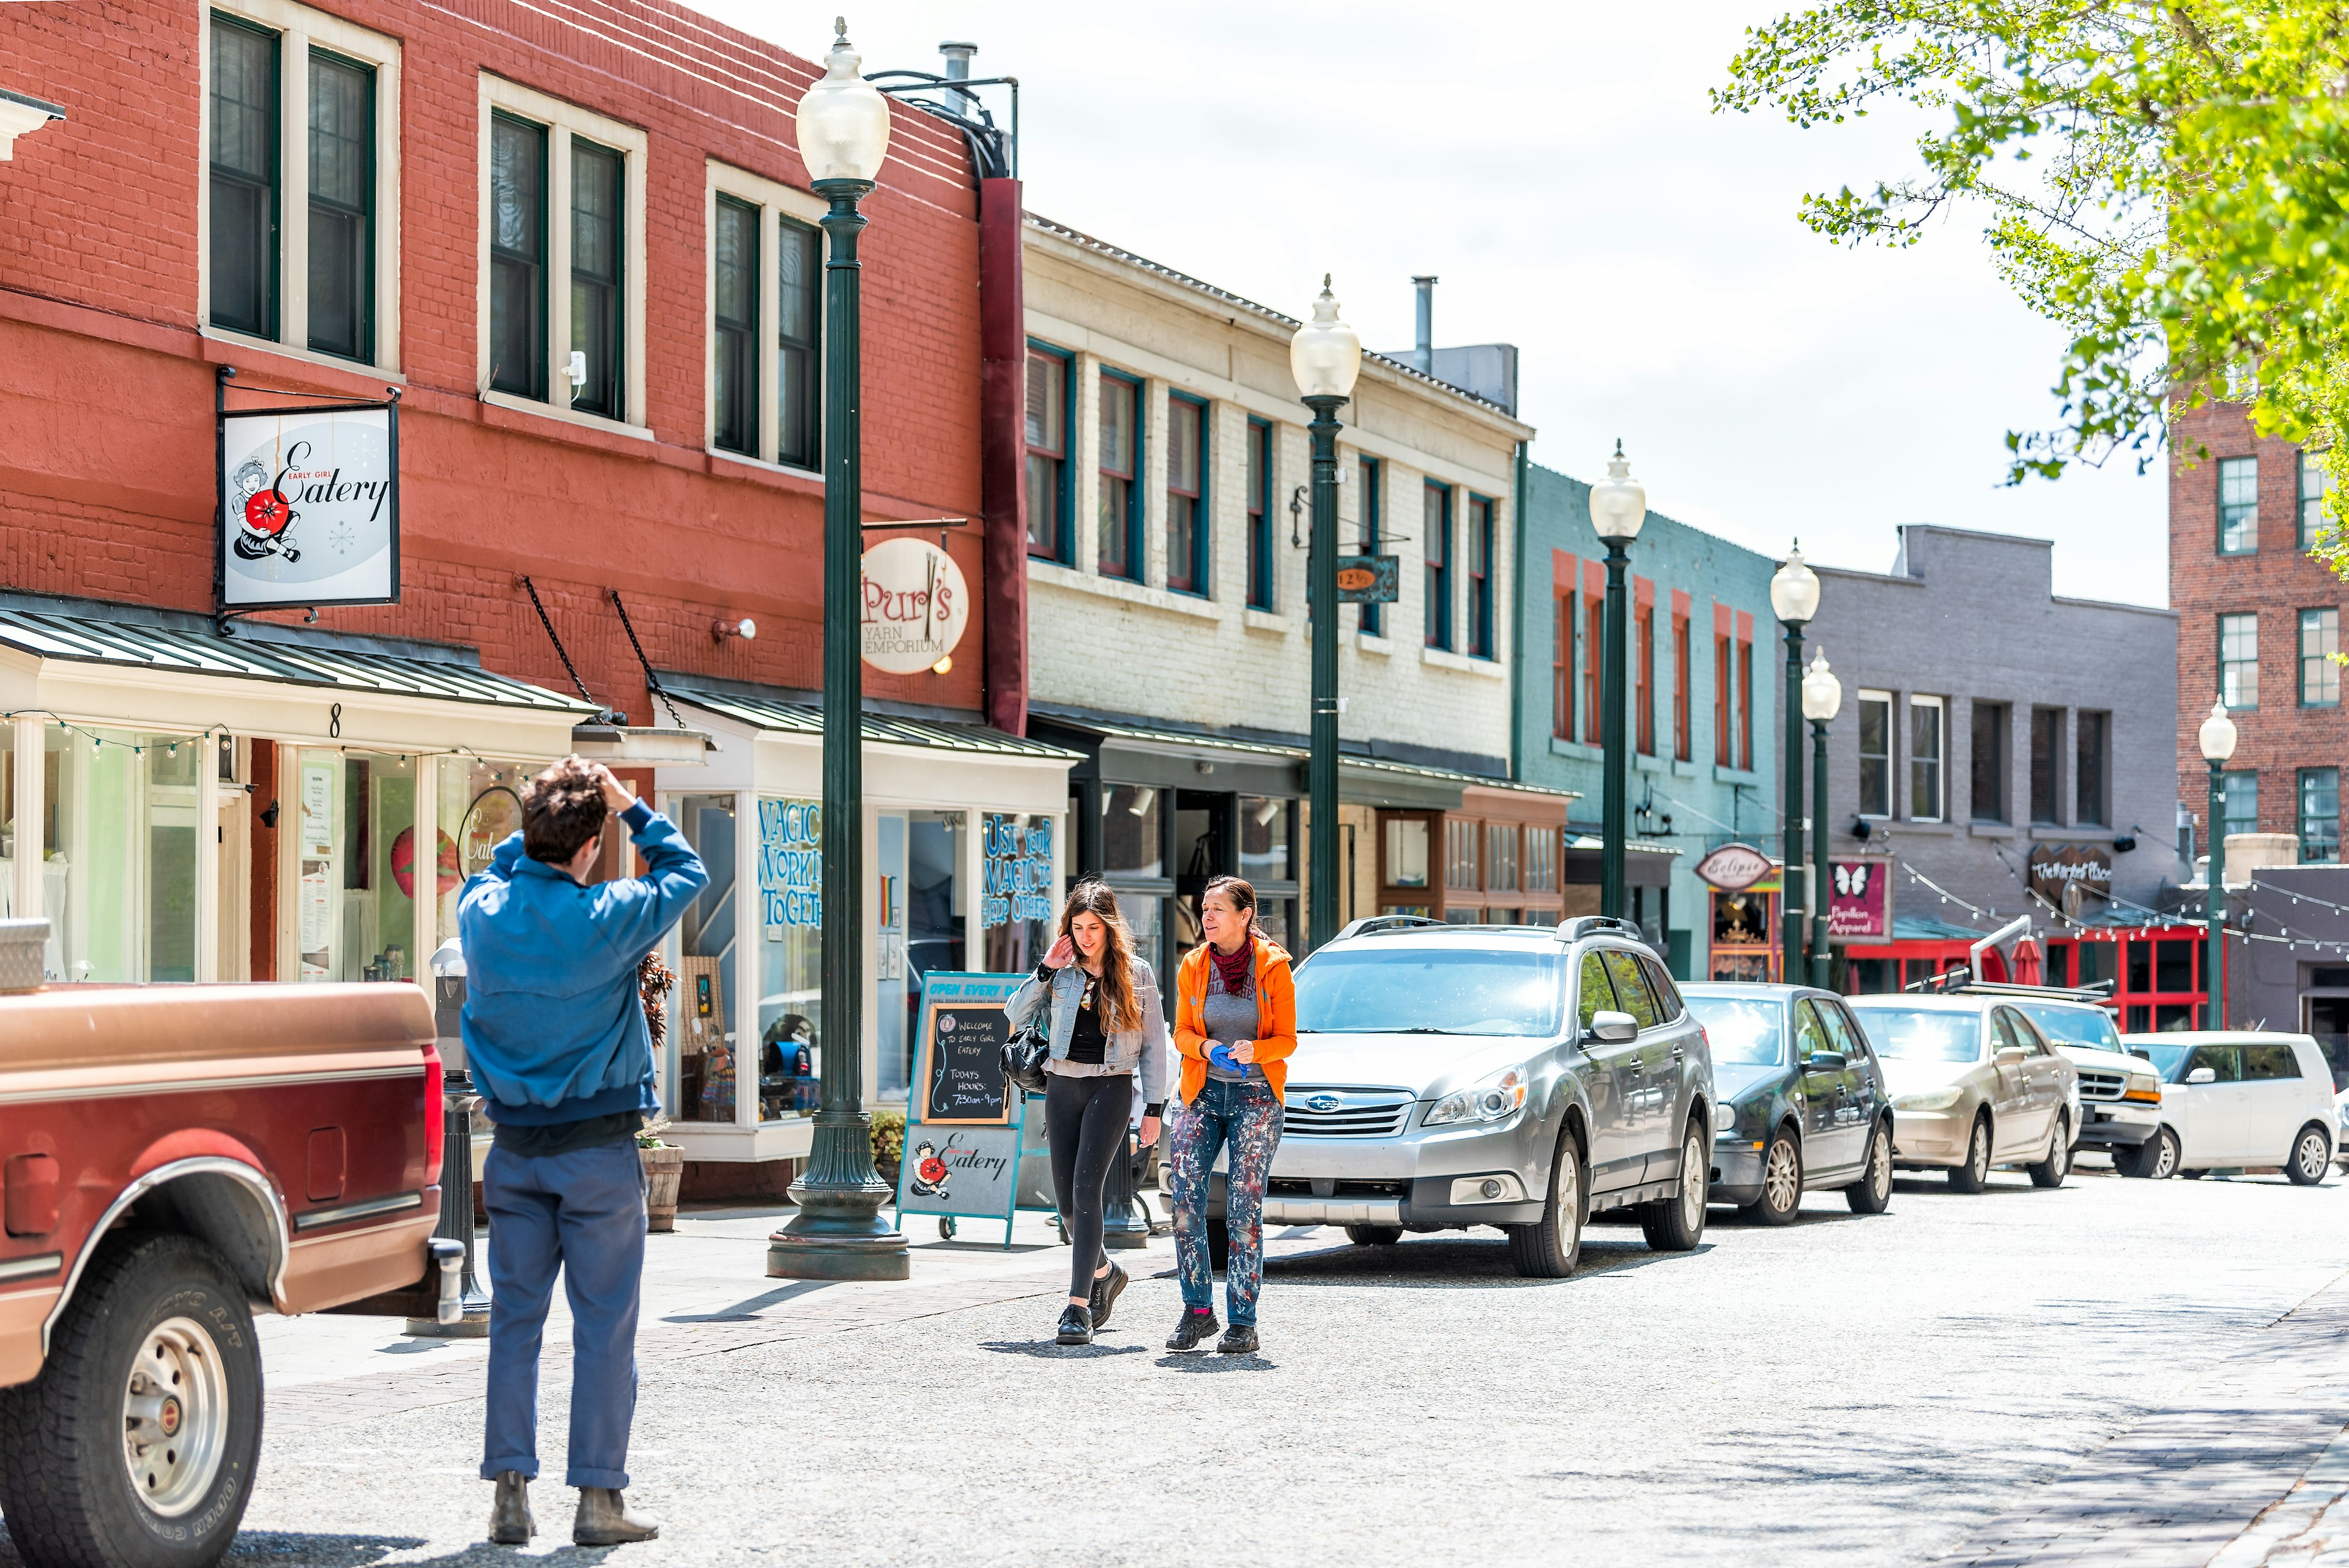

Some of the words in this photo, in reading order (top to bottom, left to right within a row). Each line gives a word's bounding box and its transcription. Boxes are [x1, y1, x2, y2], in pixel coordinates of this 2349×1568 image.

[272, 441, 390, 522] Eatery
[864, 626, 902, 640] YARN
[864, 639, 944, 654] EMPORIUM
[330, 703, 341, 738] 8
[982, 857, 1037, 895] MAGIC
[981, 894, 1009, 927] HELP
[1012, 894, 1051, 924] OTHERS
[1831, 905, 1869, 923] Papillon
[1827, 920, 1872, 936] Apparel
[930, 983, 961, 995] OPEN
[965, 984, 1001, 997] EVERY
[959, 1022, 992, 1031] WELCOME
[979, 1034, 995, 1042] GIRL
[957, 1046, 982, 1056] EATERY
[950, 1069, 979, 1080] TODAYS
[958, 1082, 987, 1091] HOURS:
[937, 1132, 1007, 1181] Eatery
[192, 1477, 237, 1537] OPEN
